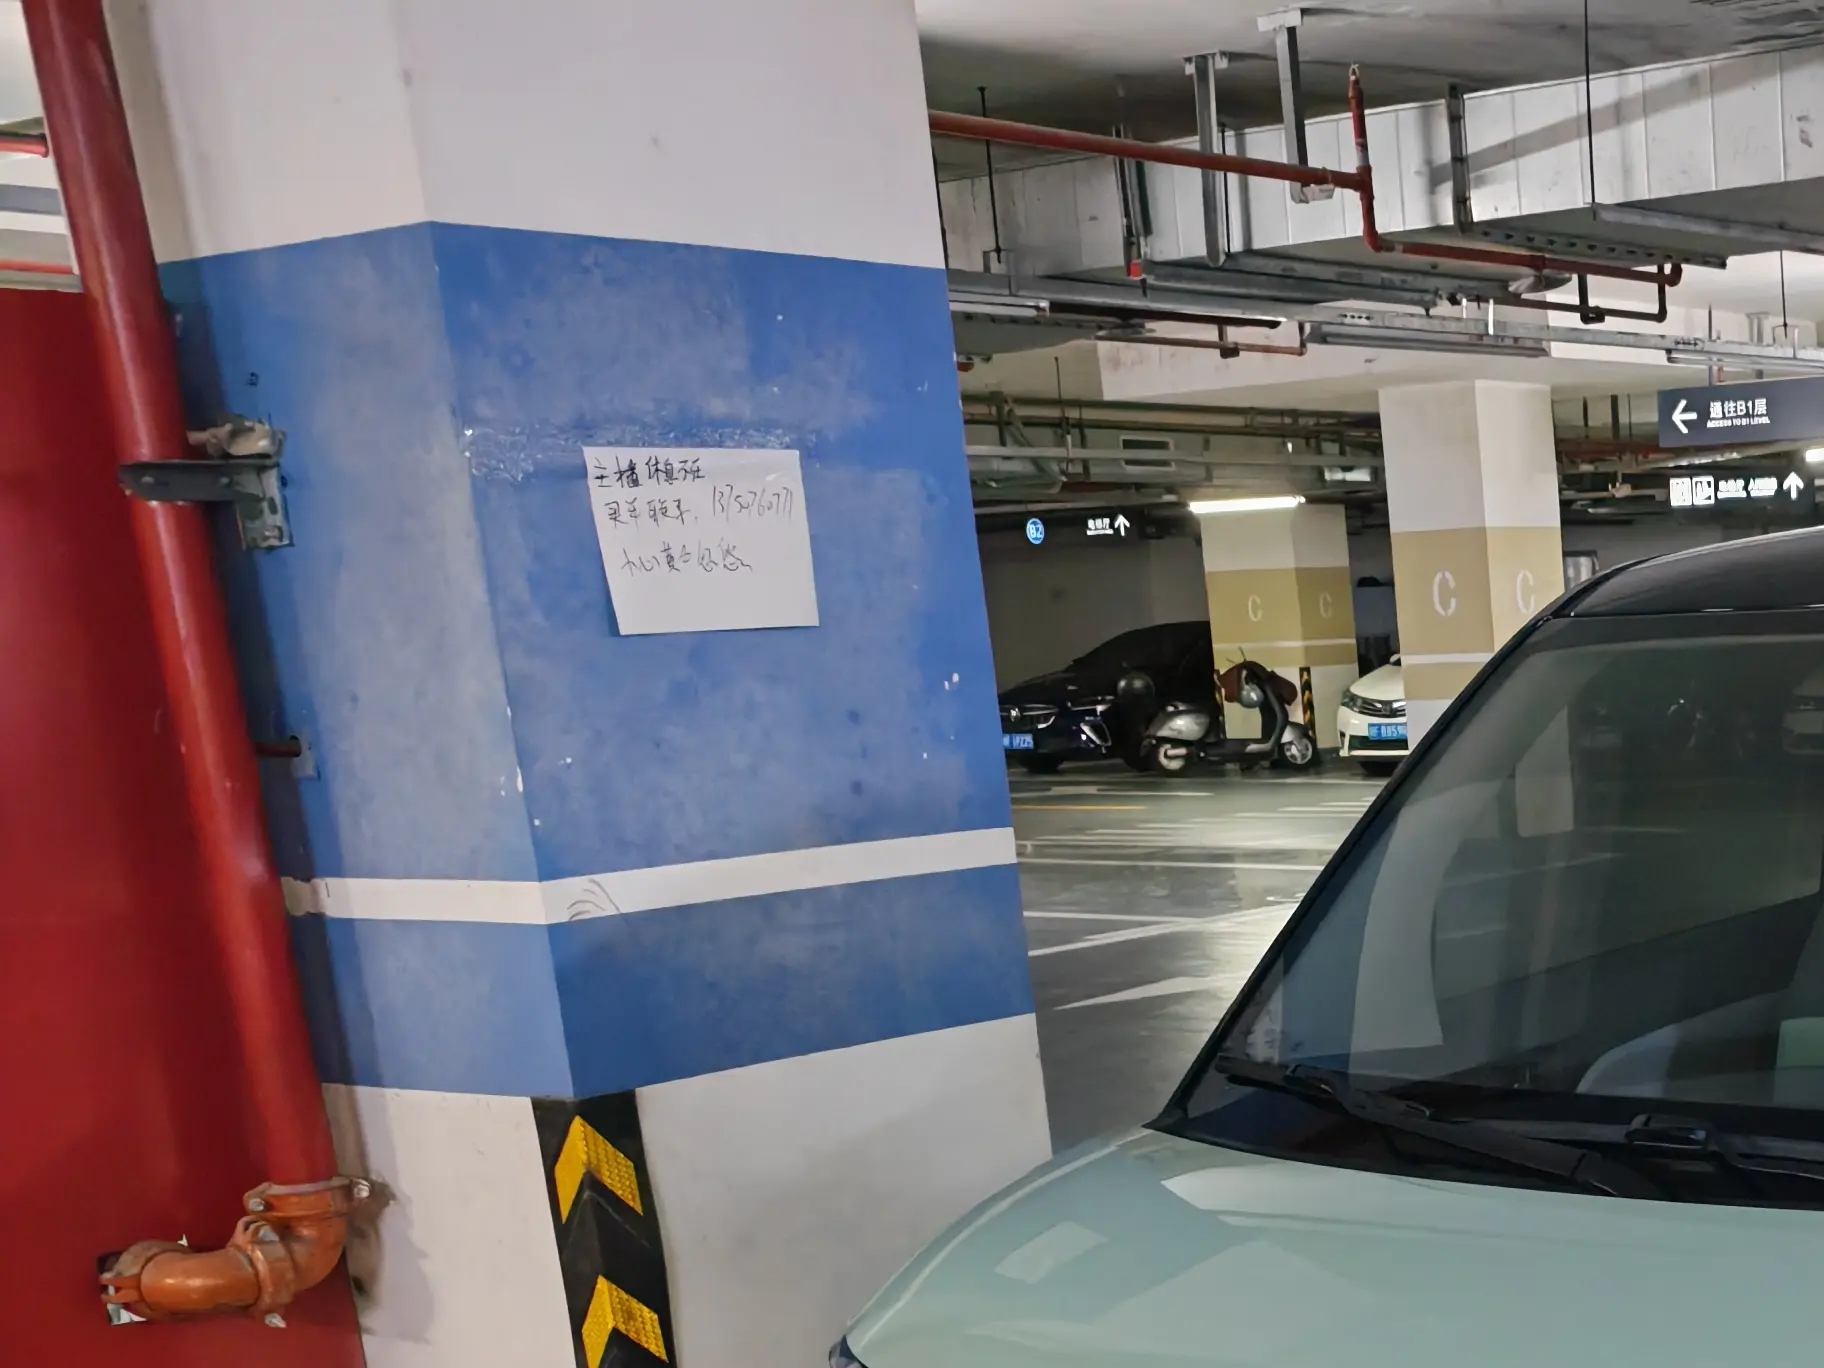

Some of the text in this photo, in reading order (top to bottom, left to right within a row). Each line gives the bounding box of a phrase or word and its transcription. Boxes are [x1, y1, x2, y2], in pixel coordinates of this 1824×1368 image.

[1247, 594, 1263, 622] C
[1319, 591, 1333, 618] C
[1433, 570, 1457, 617] C
[1516, 569, 1536, 614] C
